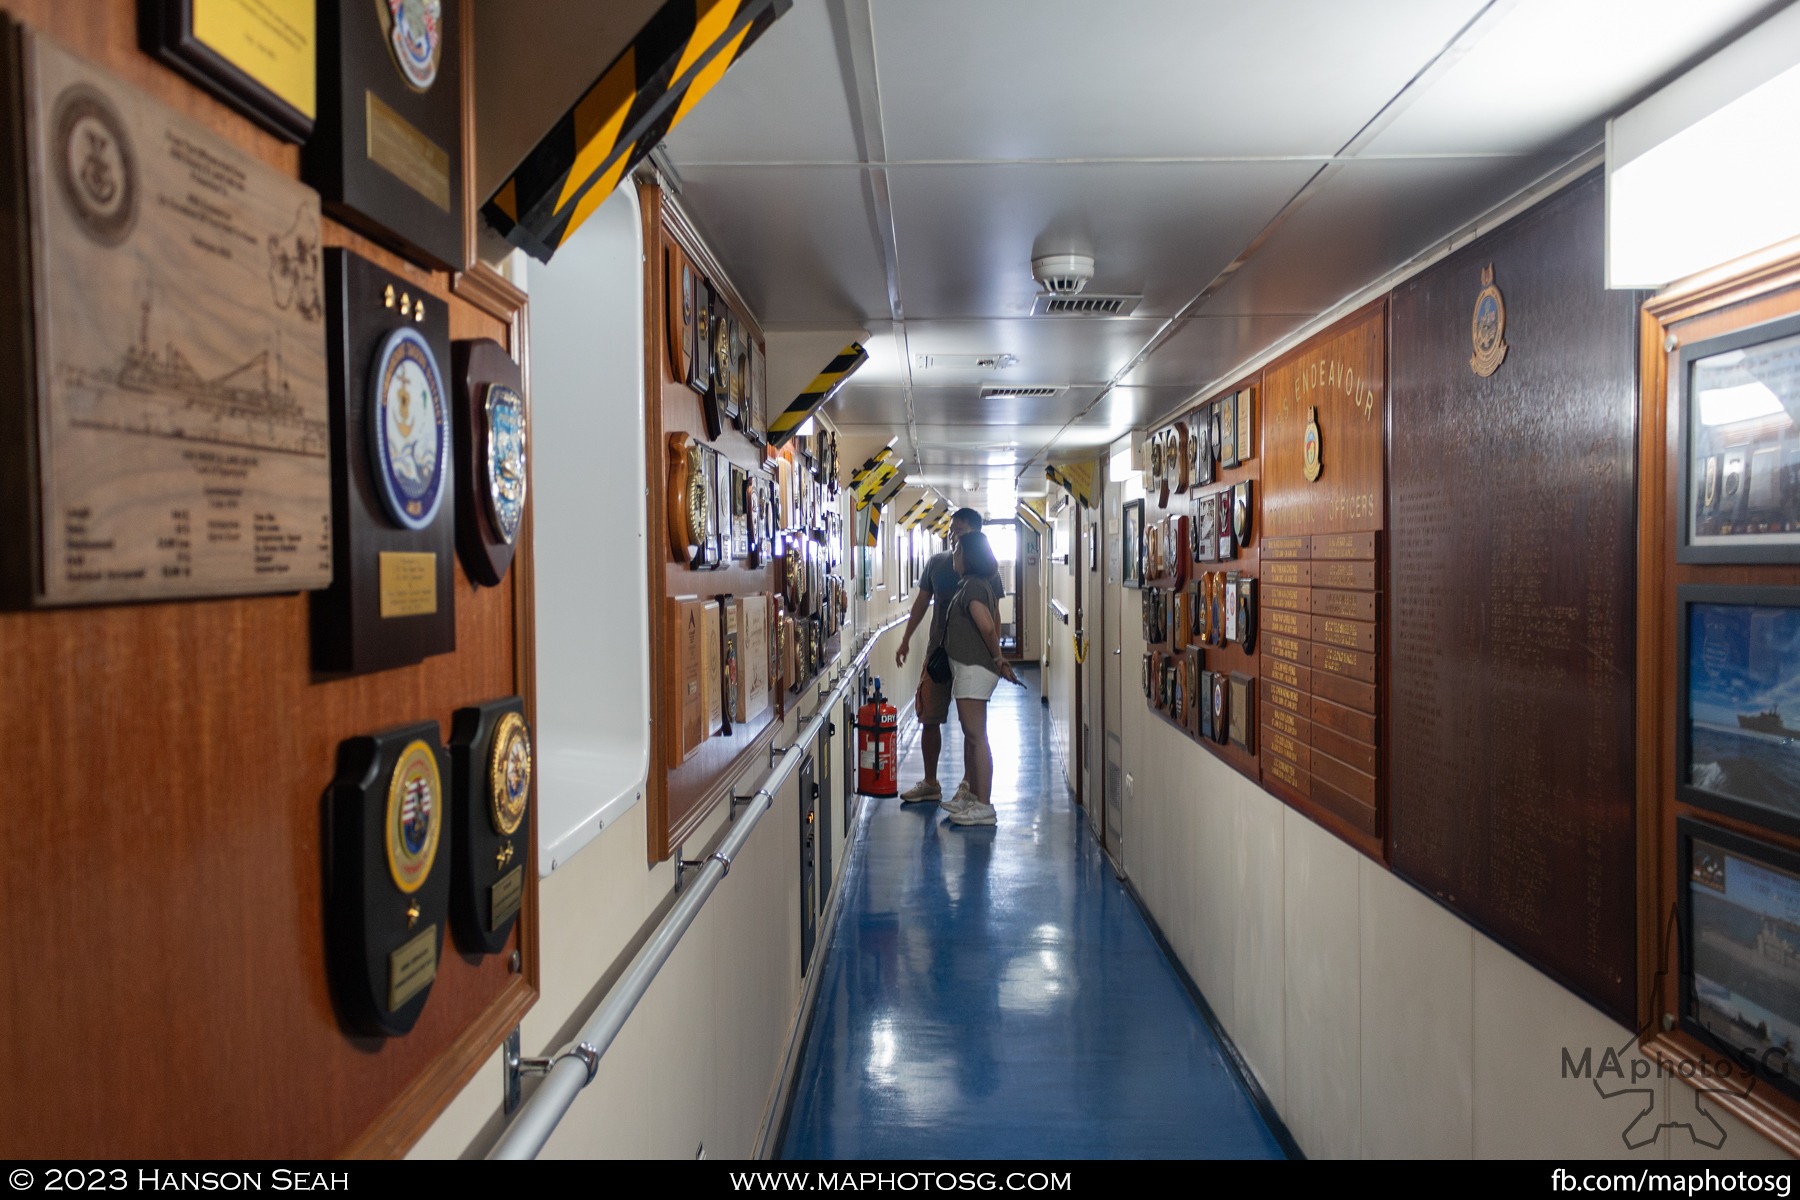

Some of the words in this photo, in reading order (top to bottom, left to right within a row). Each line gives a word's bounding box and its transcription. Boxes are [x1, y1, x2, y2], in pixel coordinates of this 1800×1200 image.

[1295, 360, 1374, 421] ENDEAVOUR
[1328, 494, 1374, 521] OFFICERS
[881, 714, 895, 723] DRY
